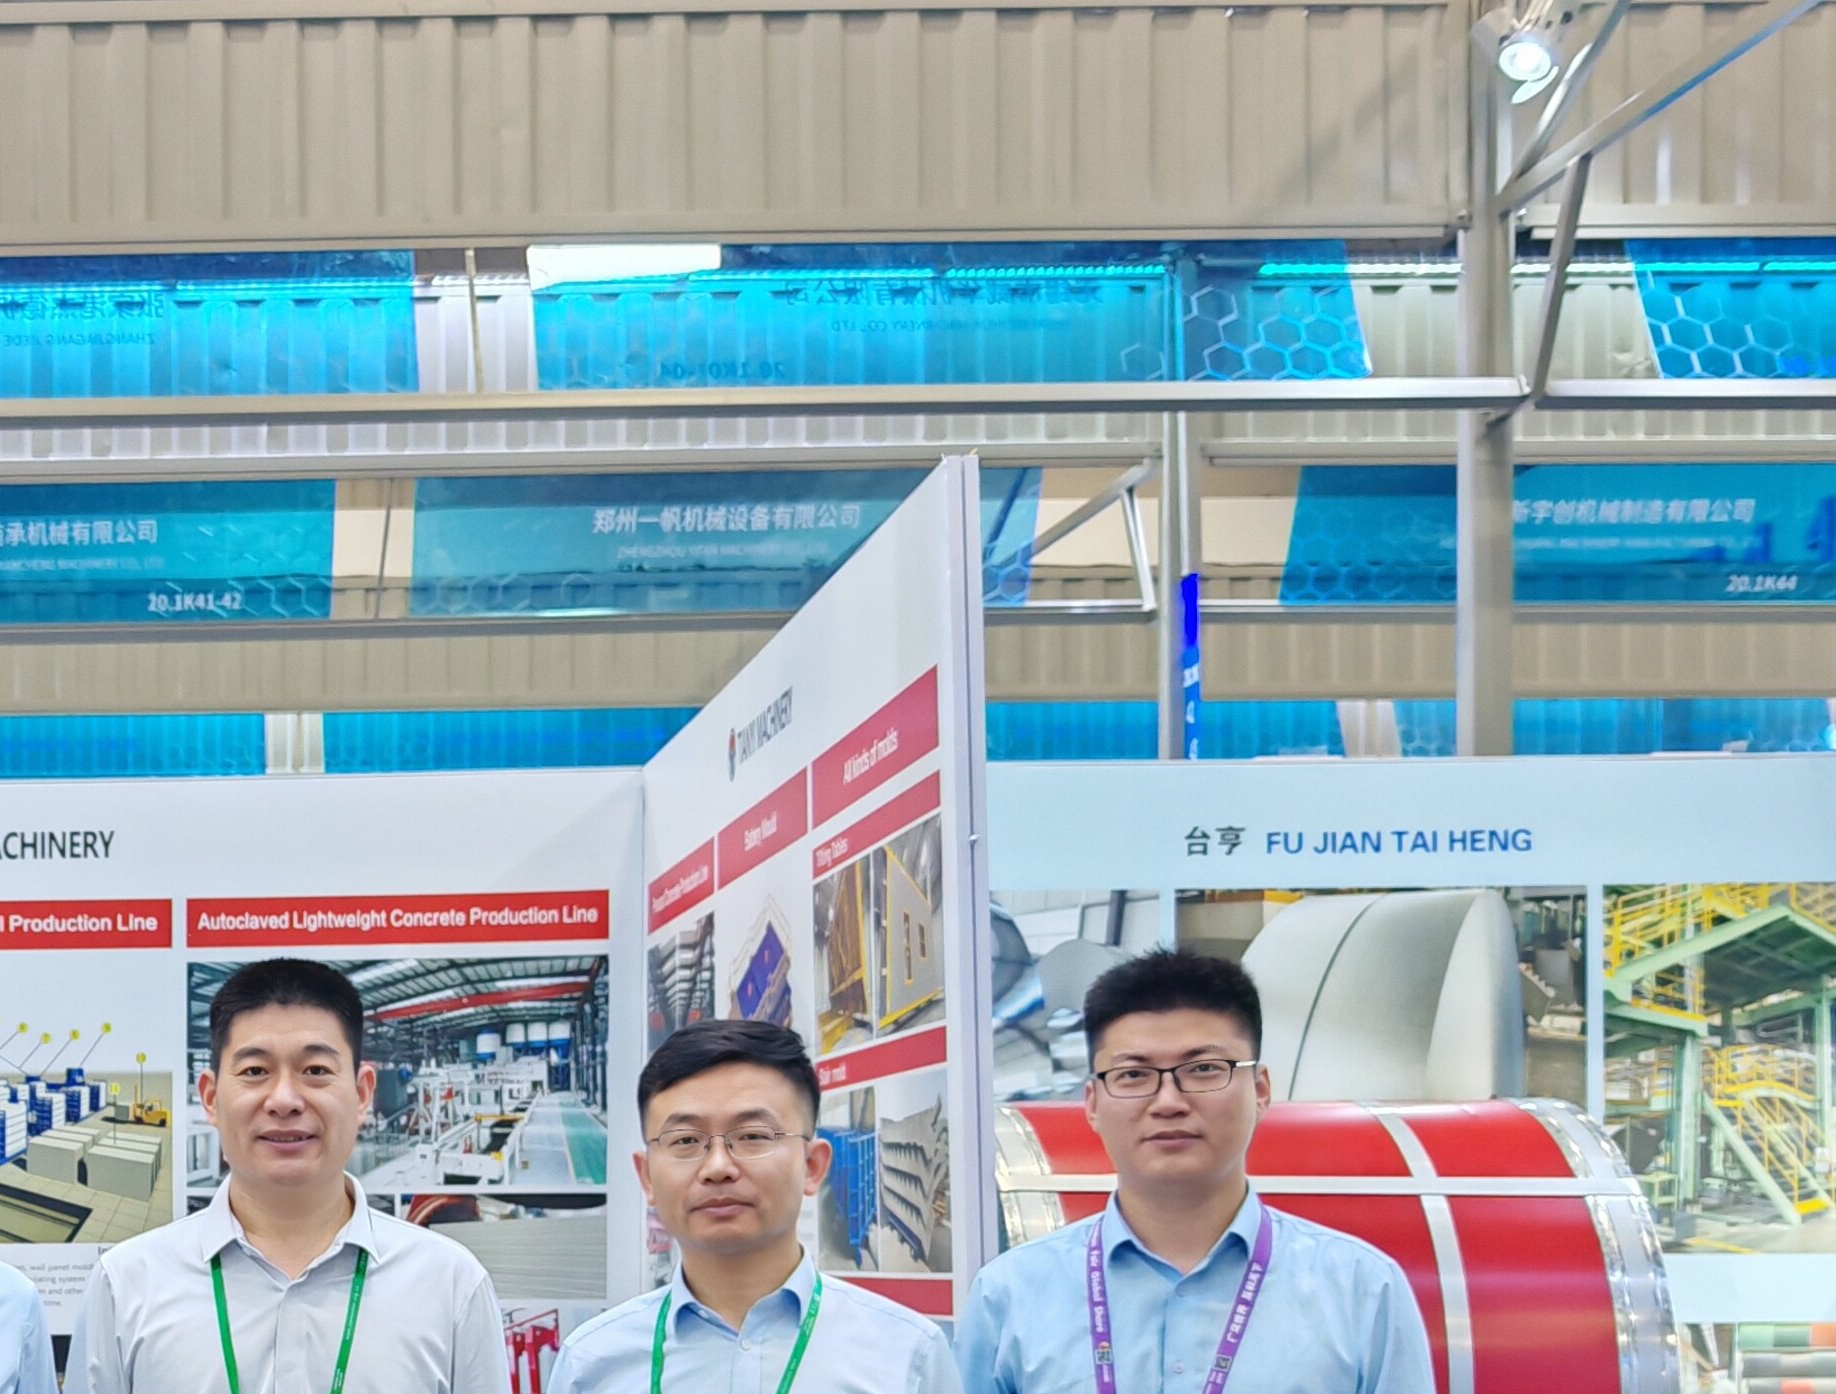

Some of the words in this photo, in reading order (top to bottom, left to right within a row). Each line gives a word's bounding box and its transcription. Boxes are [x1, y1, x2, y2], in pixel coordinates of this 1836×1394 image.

[1184, 826, 1246, 856] 台亨
[1266, 832, 1303, 854] FU
[1313, 831, 1382, 854] JIAN
[1391, 830, 1438, 853] TAI
[1448, 829, 1533, 853] HENG
[9, 914, 111, 933] Production
[117, 913, 158, 932] Line
[197, 911, 290, 930] Autoclaved
[293, 910, 386, 932] Lightweight
[390, 908, 466, 927] Concrete
[469, 906, 558, 926] Production
[562, 905, 598, 924] Line
